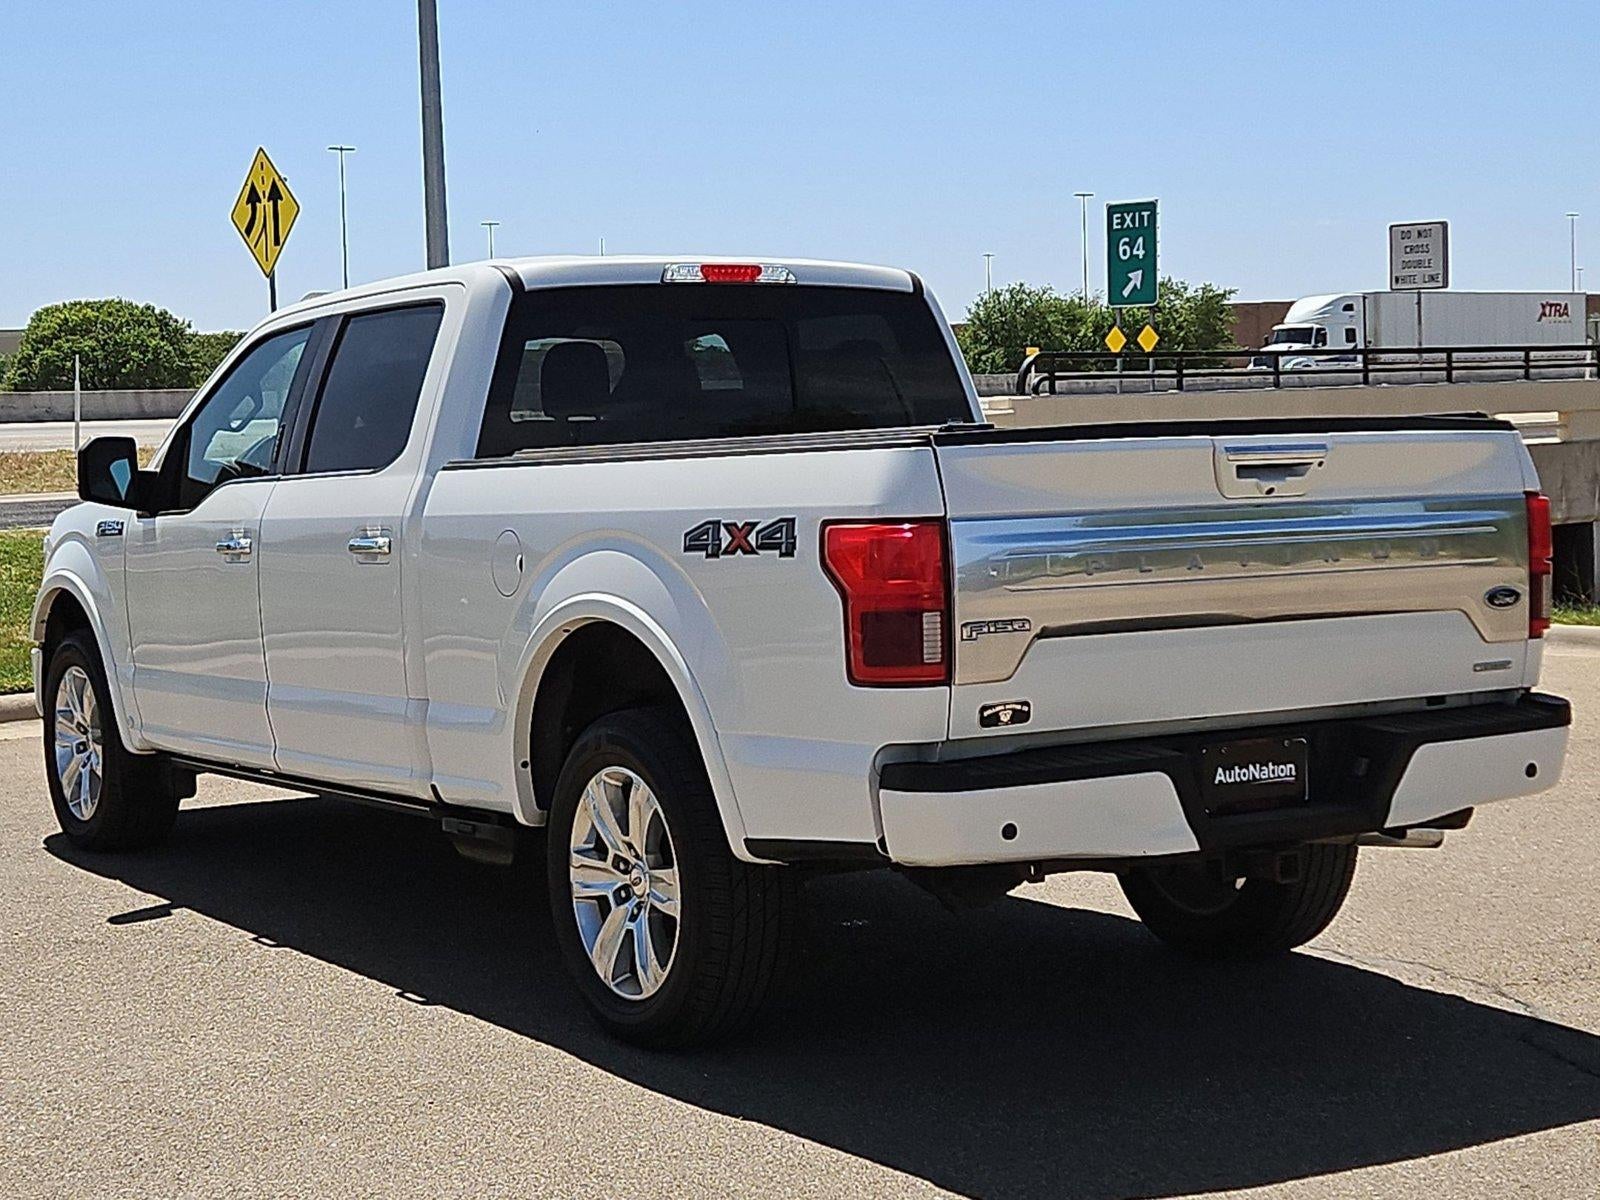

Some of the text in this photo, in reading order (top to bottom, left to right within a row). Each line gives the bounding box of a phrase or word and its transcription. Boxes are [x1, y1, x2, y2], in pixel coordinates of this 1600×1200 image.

[1112, 211, 1151, 230] EXIT
[1400, 228, 1432, 240] DO NOT
[1118, 236, 1146, 261] 64
[1404, 243, 1430, 255] CROSS
[1401, 258, 1432, 270] DOUBLE
[1394, 272, 1441, 285] WHITE LINE
[1536, 301, 1570, 322] XTRA
[1214, 761, 1297, 784] AutoNation
